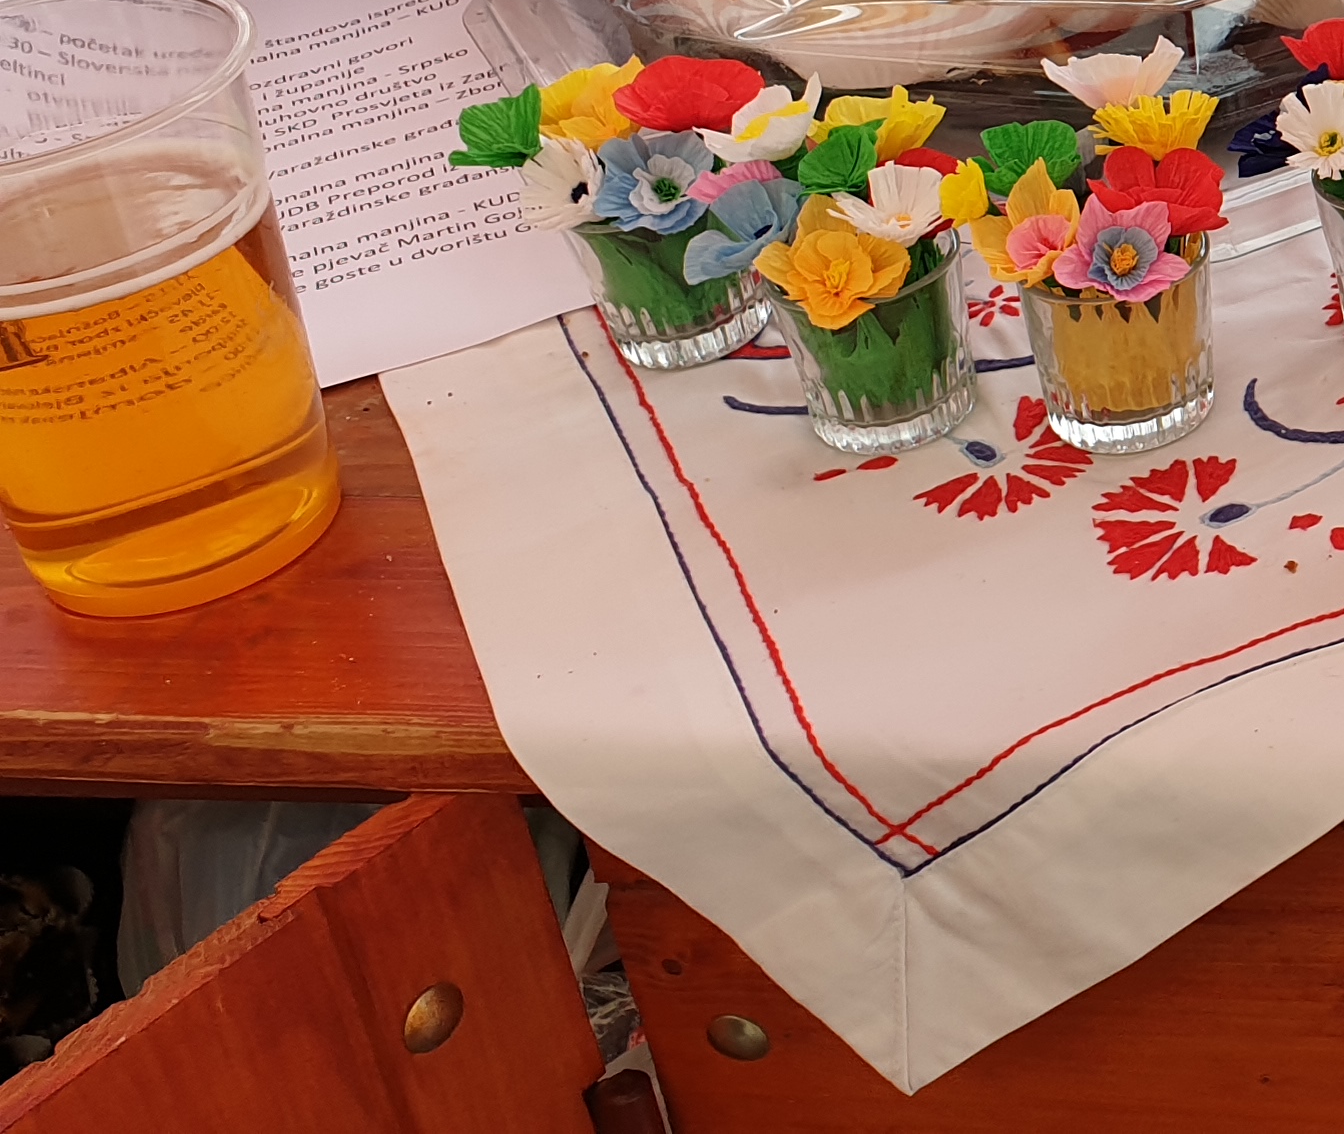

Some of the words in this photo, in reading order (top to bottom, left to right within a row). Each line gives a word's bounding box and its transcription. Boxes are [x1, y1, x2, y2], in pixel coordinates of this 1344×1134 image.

[264, 18, 362, 49] štandova
[308, 20, 392, 51] manjina
[348, 35, 414, 66] govori
[275, 66, 366, 100] županije
[291, 77, 378, 110] manjina
[397, 47, 469, 78] Srpsko
[355, 71, 438, 102] društvo
[274, 118, 318, 138] SKD
[331, 85, 433, 122] Prosvjeta
[440, 81, 456, 93] iz
[341, 101, 430, 132] manjina
[355, 150, 446, 184] manjina
[327, 167, 436, 206] Preporod
[356, 210, 452, 245] manjina
[472, 190, 521, 213] KUD
[313, 242, 392, 277] pjevač
[396, 220, 478, 250] Martin
[315, 261, 383, 292] goste
[389, 256, 404, 267] u
[410, 228, 508, 261] dvorištu
